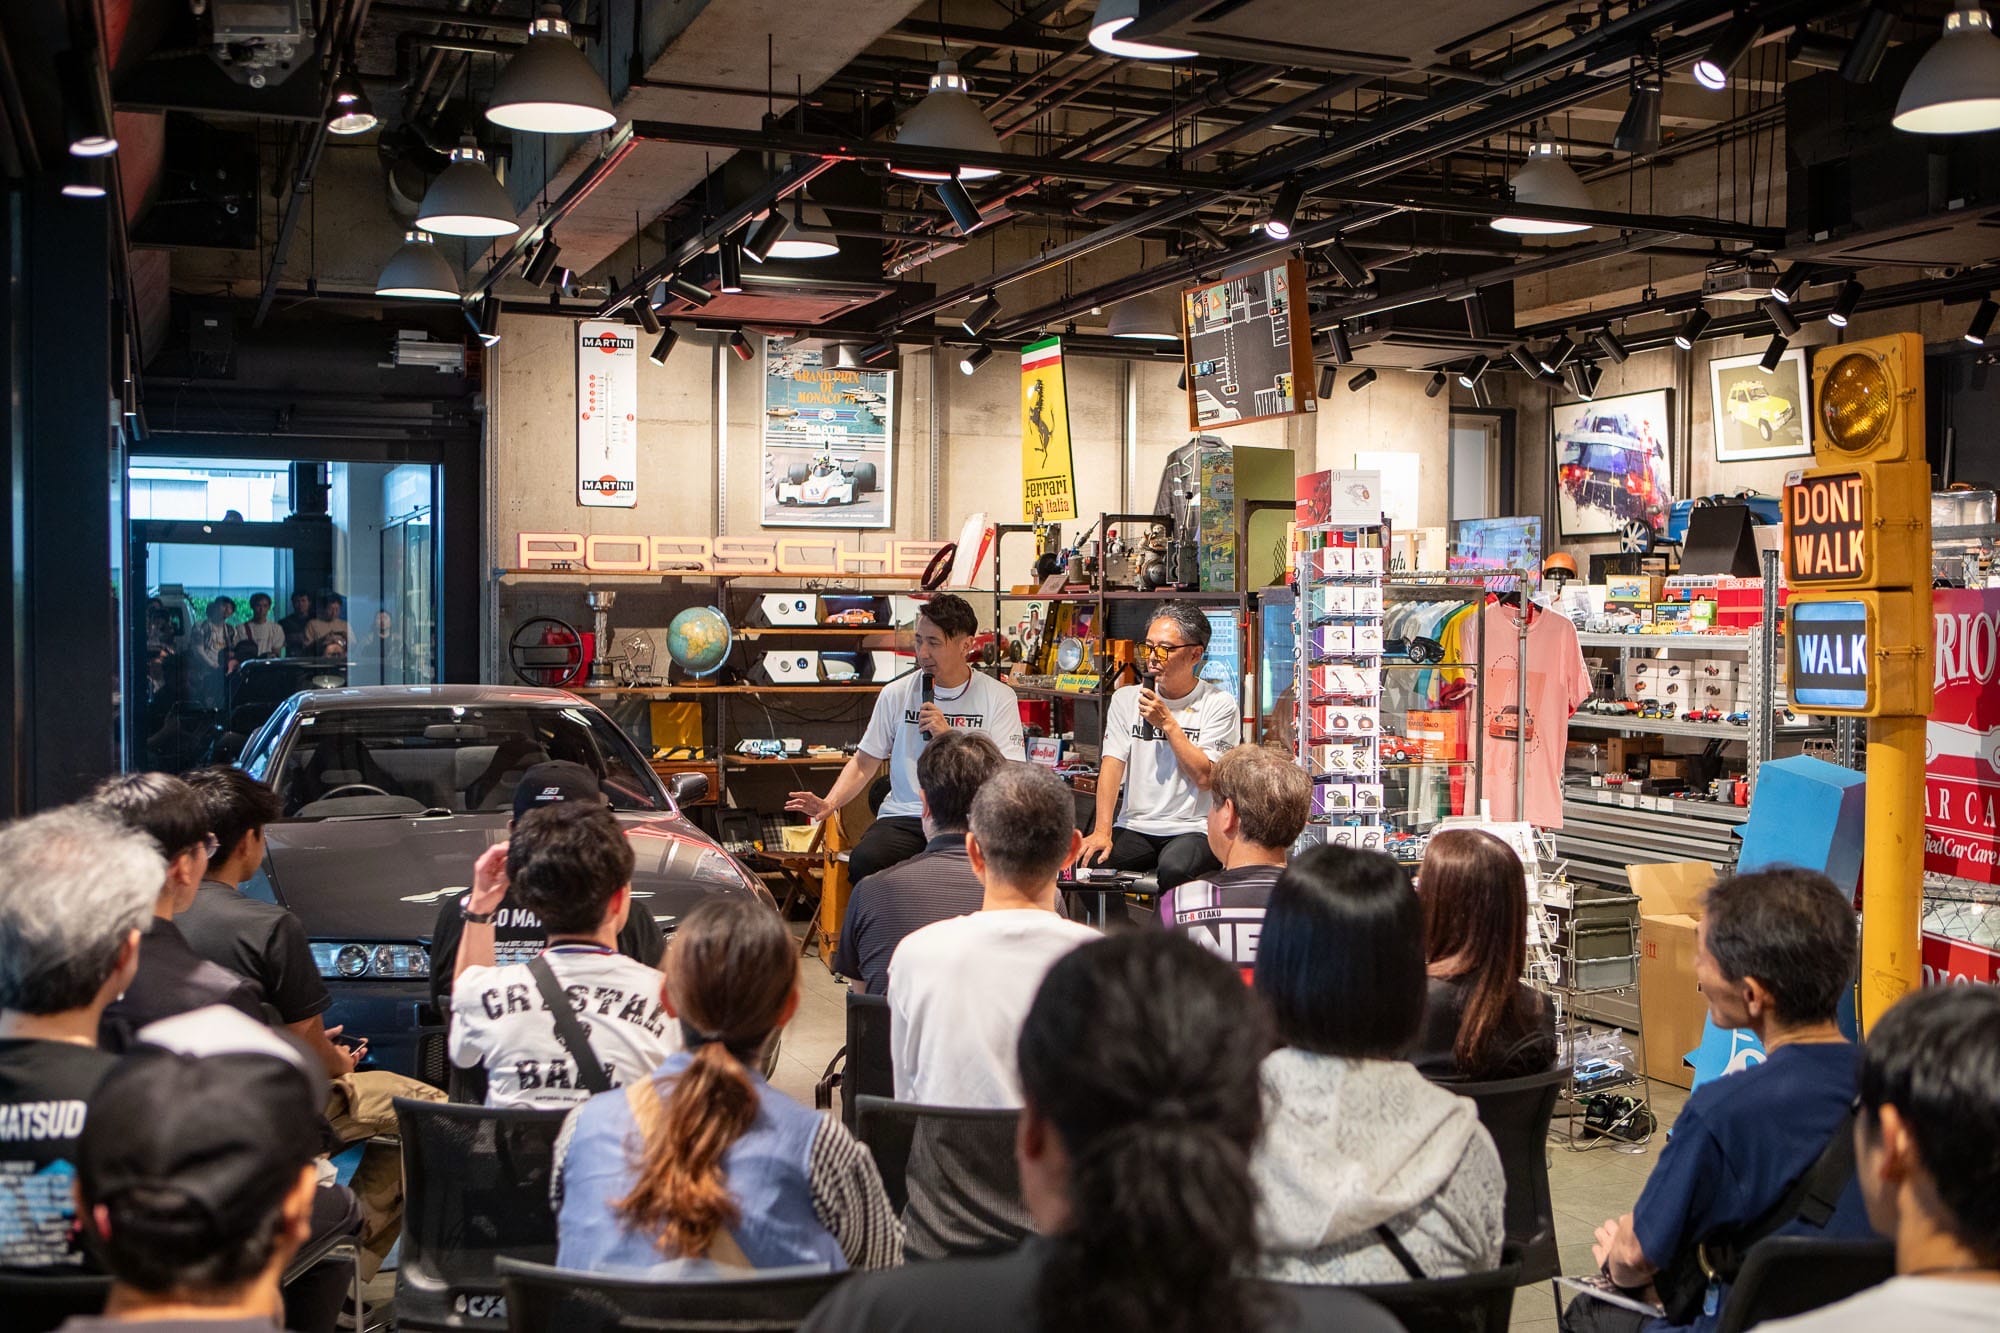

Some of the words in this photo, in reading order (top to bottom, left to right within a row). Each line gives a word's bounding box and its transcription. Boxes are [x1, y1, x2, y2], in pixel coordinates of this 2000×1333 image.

[584, 338, 633, 348] MARTINI
[793, 369, 833, 383] GRAND
[834, 370, 860, 384] PRIX
[820, 381, 835, 394] OF
[584, 481, 633, 491] MARTINI
[1025, 475, 1067, 498] Ferrari
[1025, 499, 1044, 515] Clb
[1045, 497, 1070, 513] Italia
[1793, 479, 1864, 526] DONT
[516, 532, 957, 574] PORSCHE
[1795, 529, 1864, 575] WALK
[1797, 634, 1867, 675] WALK
[1944, 837, 1967, 859] Car
[1967, 841, 1997, 865] Care
[511, 908, 542, 928] MA
[1180, 911, 1195, 923] GT-R
[1197, 909, 1222, 919] OTAKU
[481, 982, 666, 1039] CRSTAL
[516, 1059, 623, 1091] BAL
